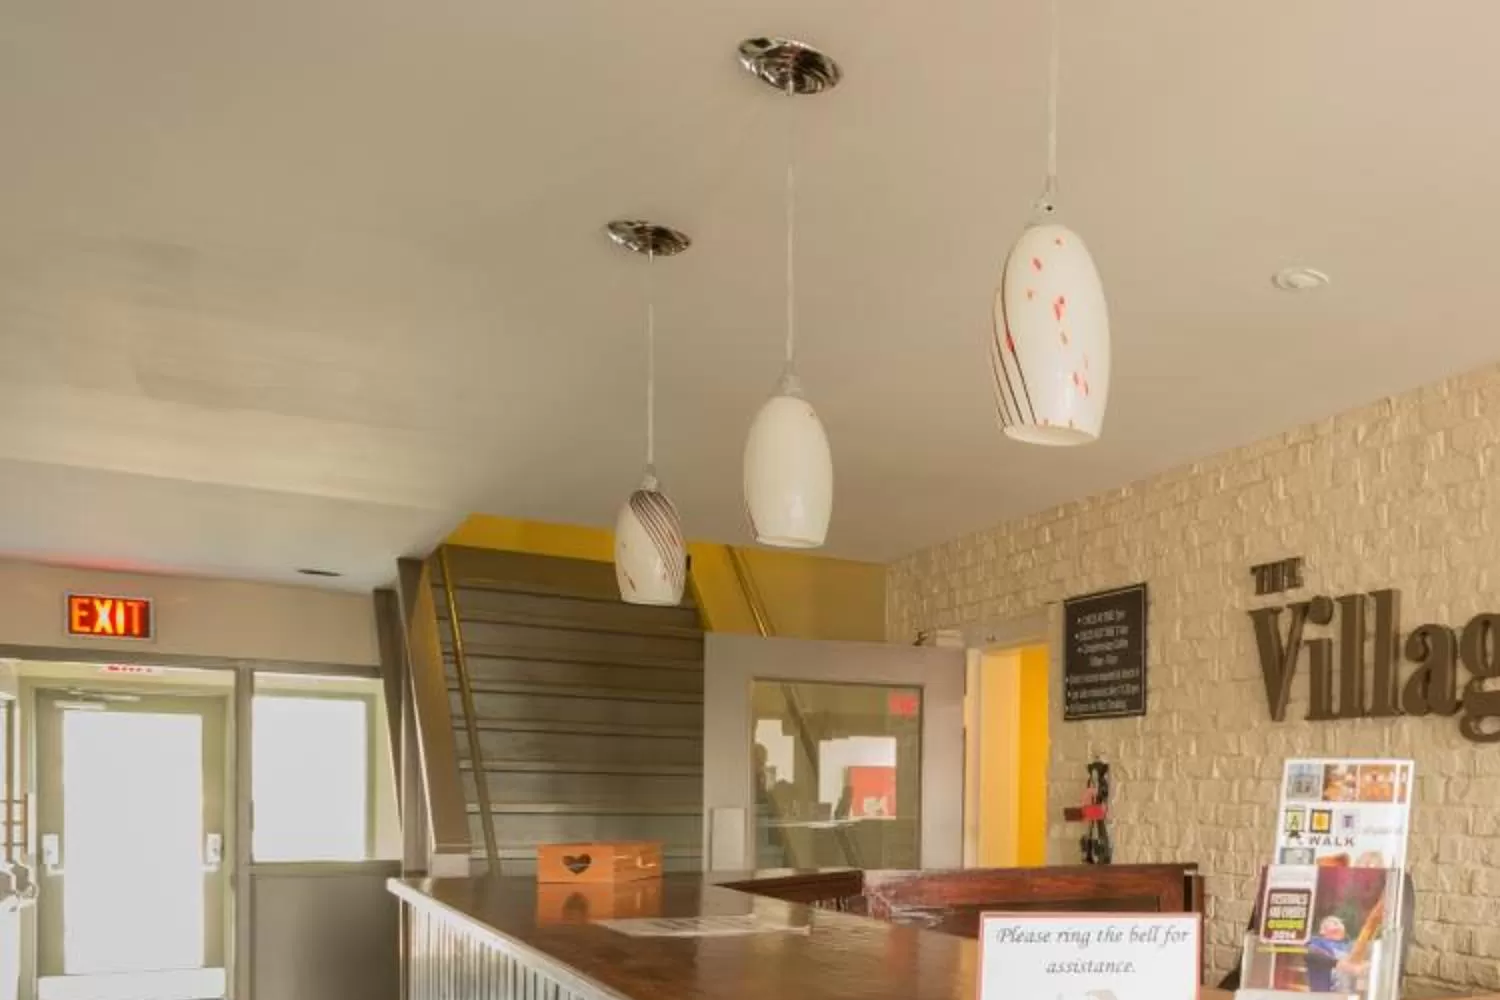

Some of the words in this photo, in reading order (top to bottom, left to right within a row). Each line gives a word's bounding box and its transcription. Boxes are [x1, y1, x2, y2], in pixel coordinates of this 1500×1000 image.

[1250, 557, 1303, 596] THE
[71, 598, 145, 635] EXIT
[1309, 835, 1354, 847] WALK
[997, 925, 1051, 945] Please
[1056, 926, 1090, 948] ring
[1096, 925, 1124, 943] the
[1129, 924, 1159, 942] bell
[1160, 924, 1191, 948] for
[1044, 958, 1136, 974] assistance.
